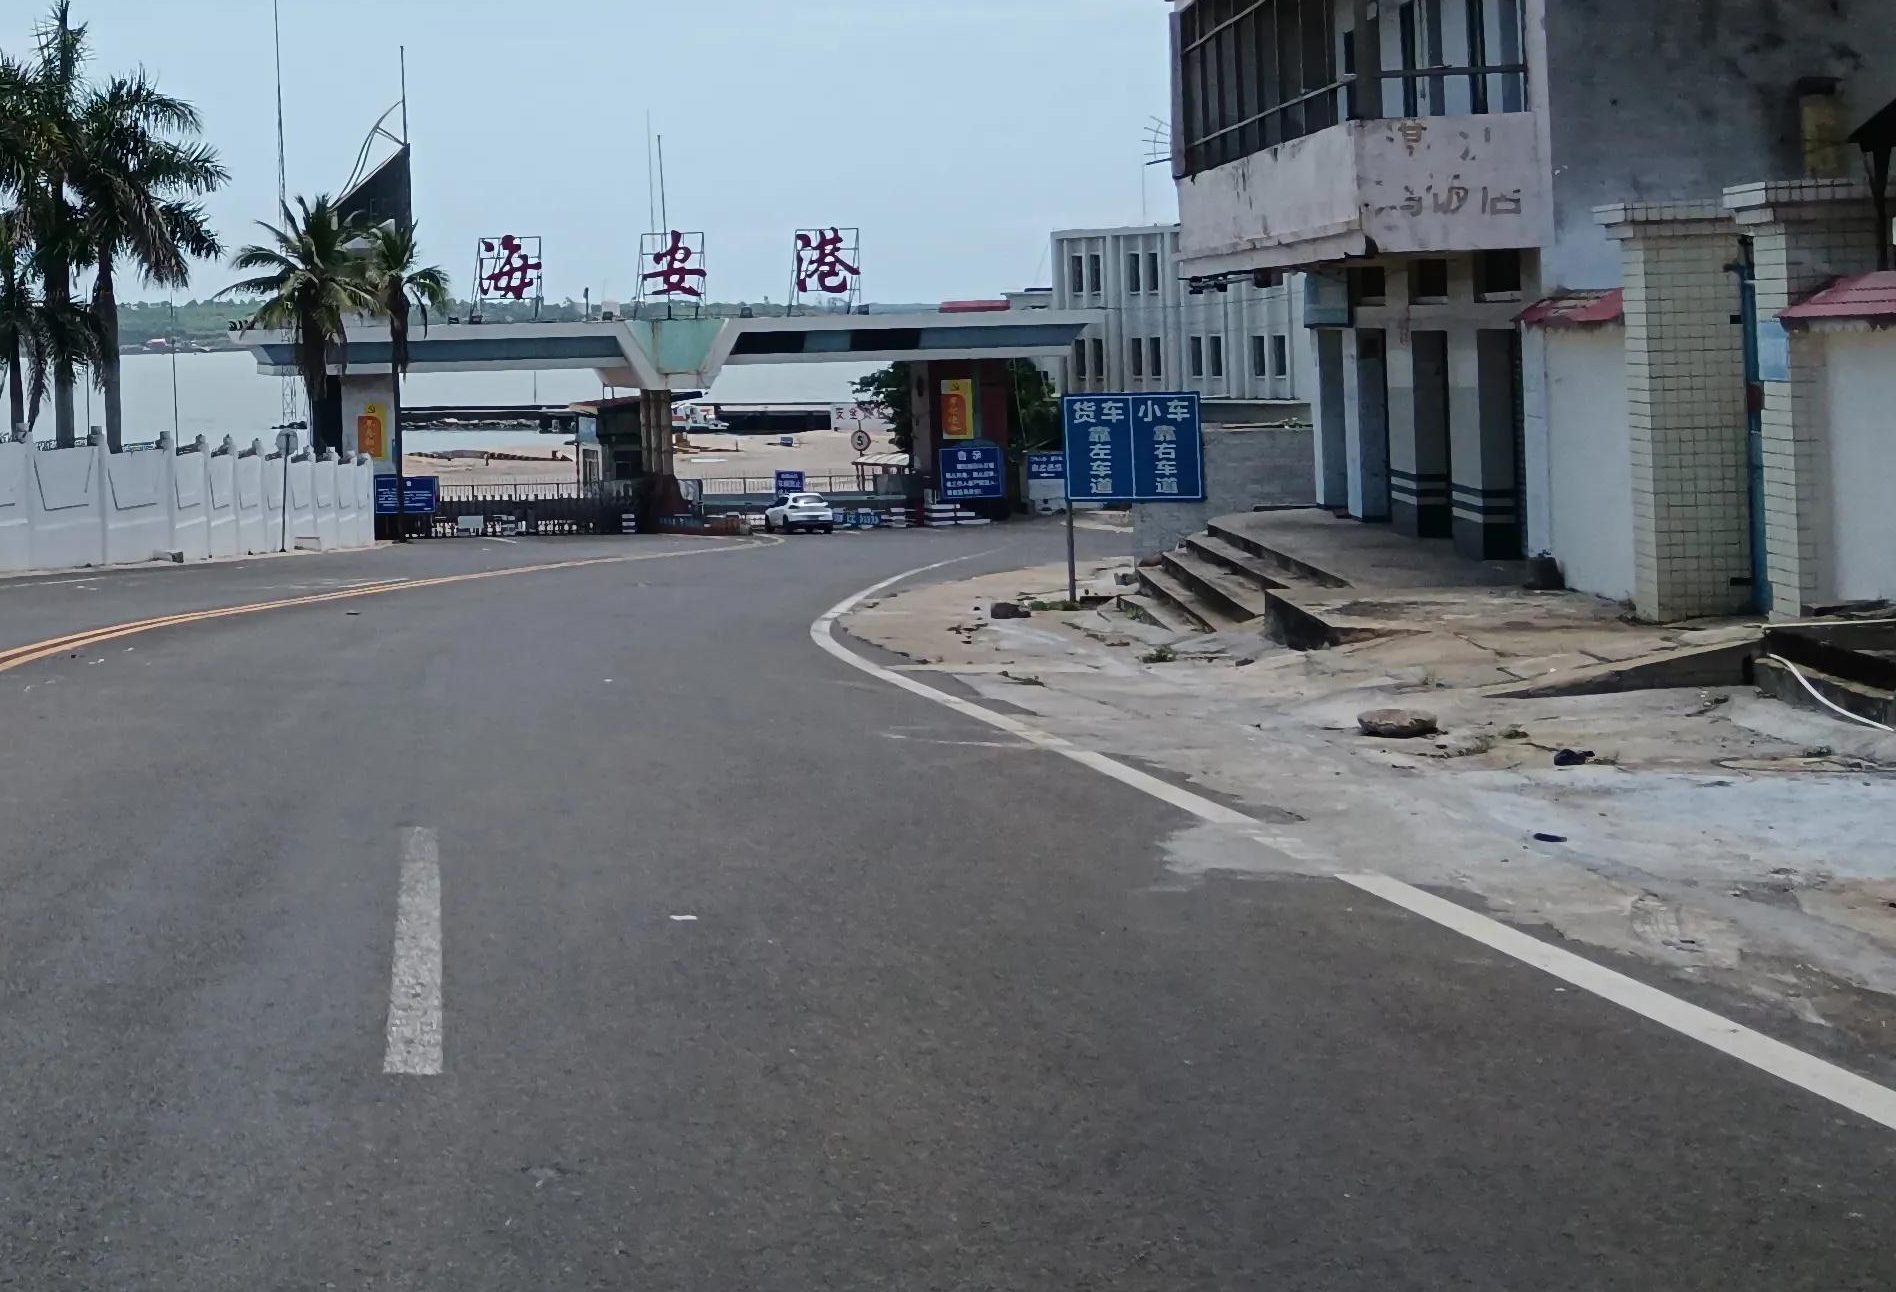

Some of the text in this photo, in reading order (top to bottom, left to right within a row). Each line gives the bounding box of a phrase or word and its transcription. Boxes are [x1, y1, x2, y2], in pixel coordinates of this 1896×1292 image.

[479, 227, 861, 300] 海安港
[1073, 401, 1124, 423] 货车
[1138, 399, 1190, 422] 小车
